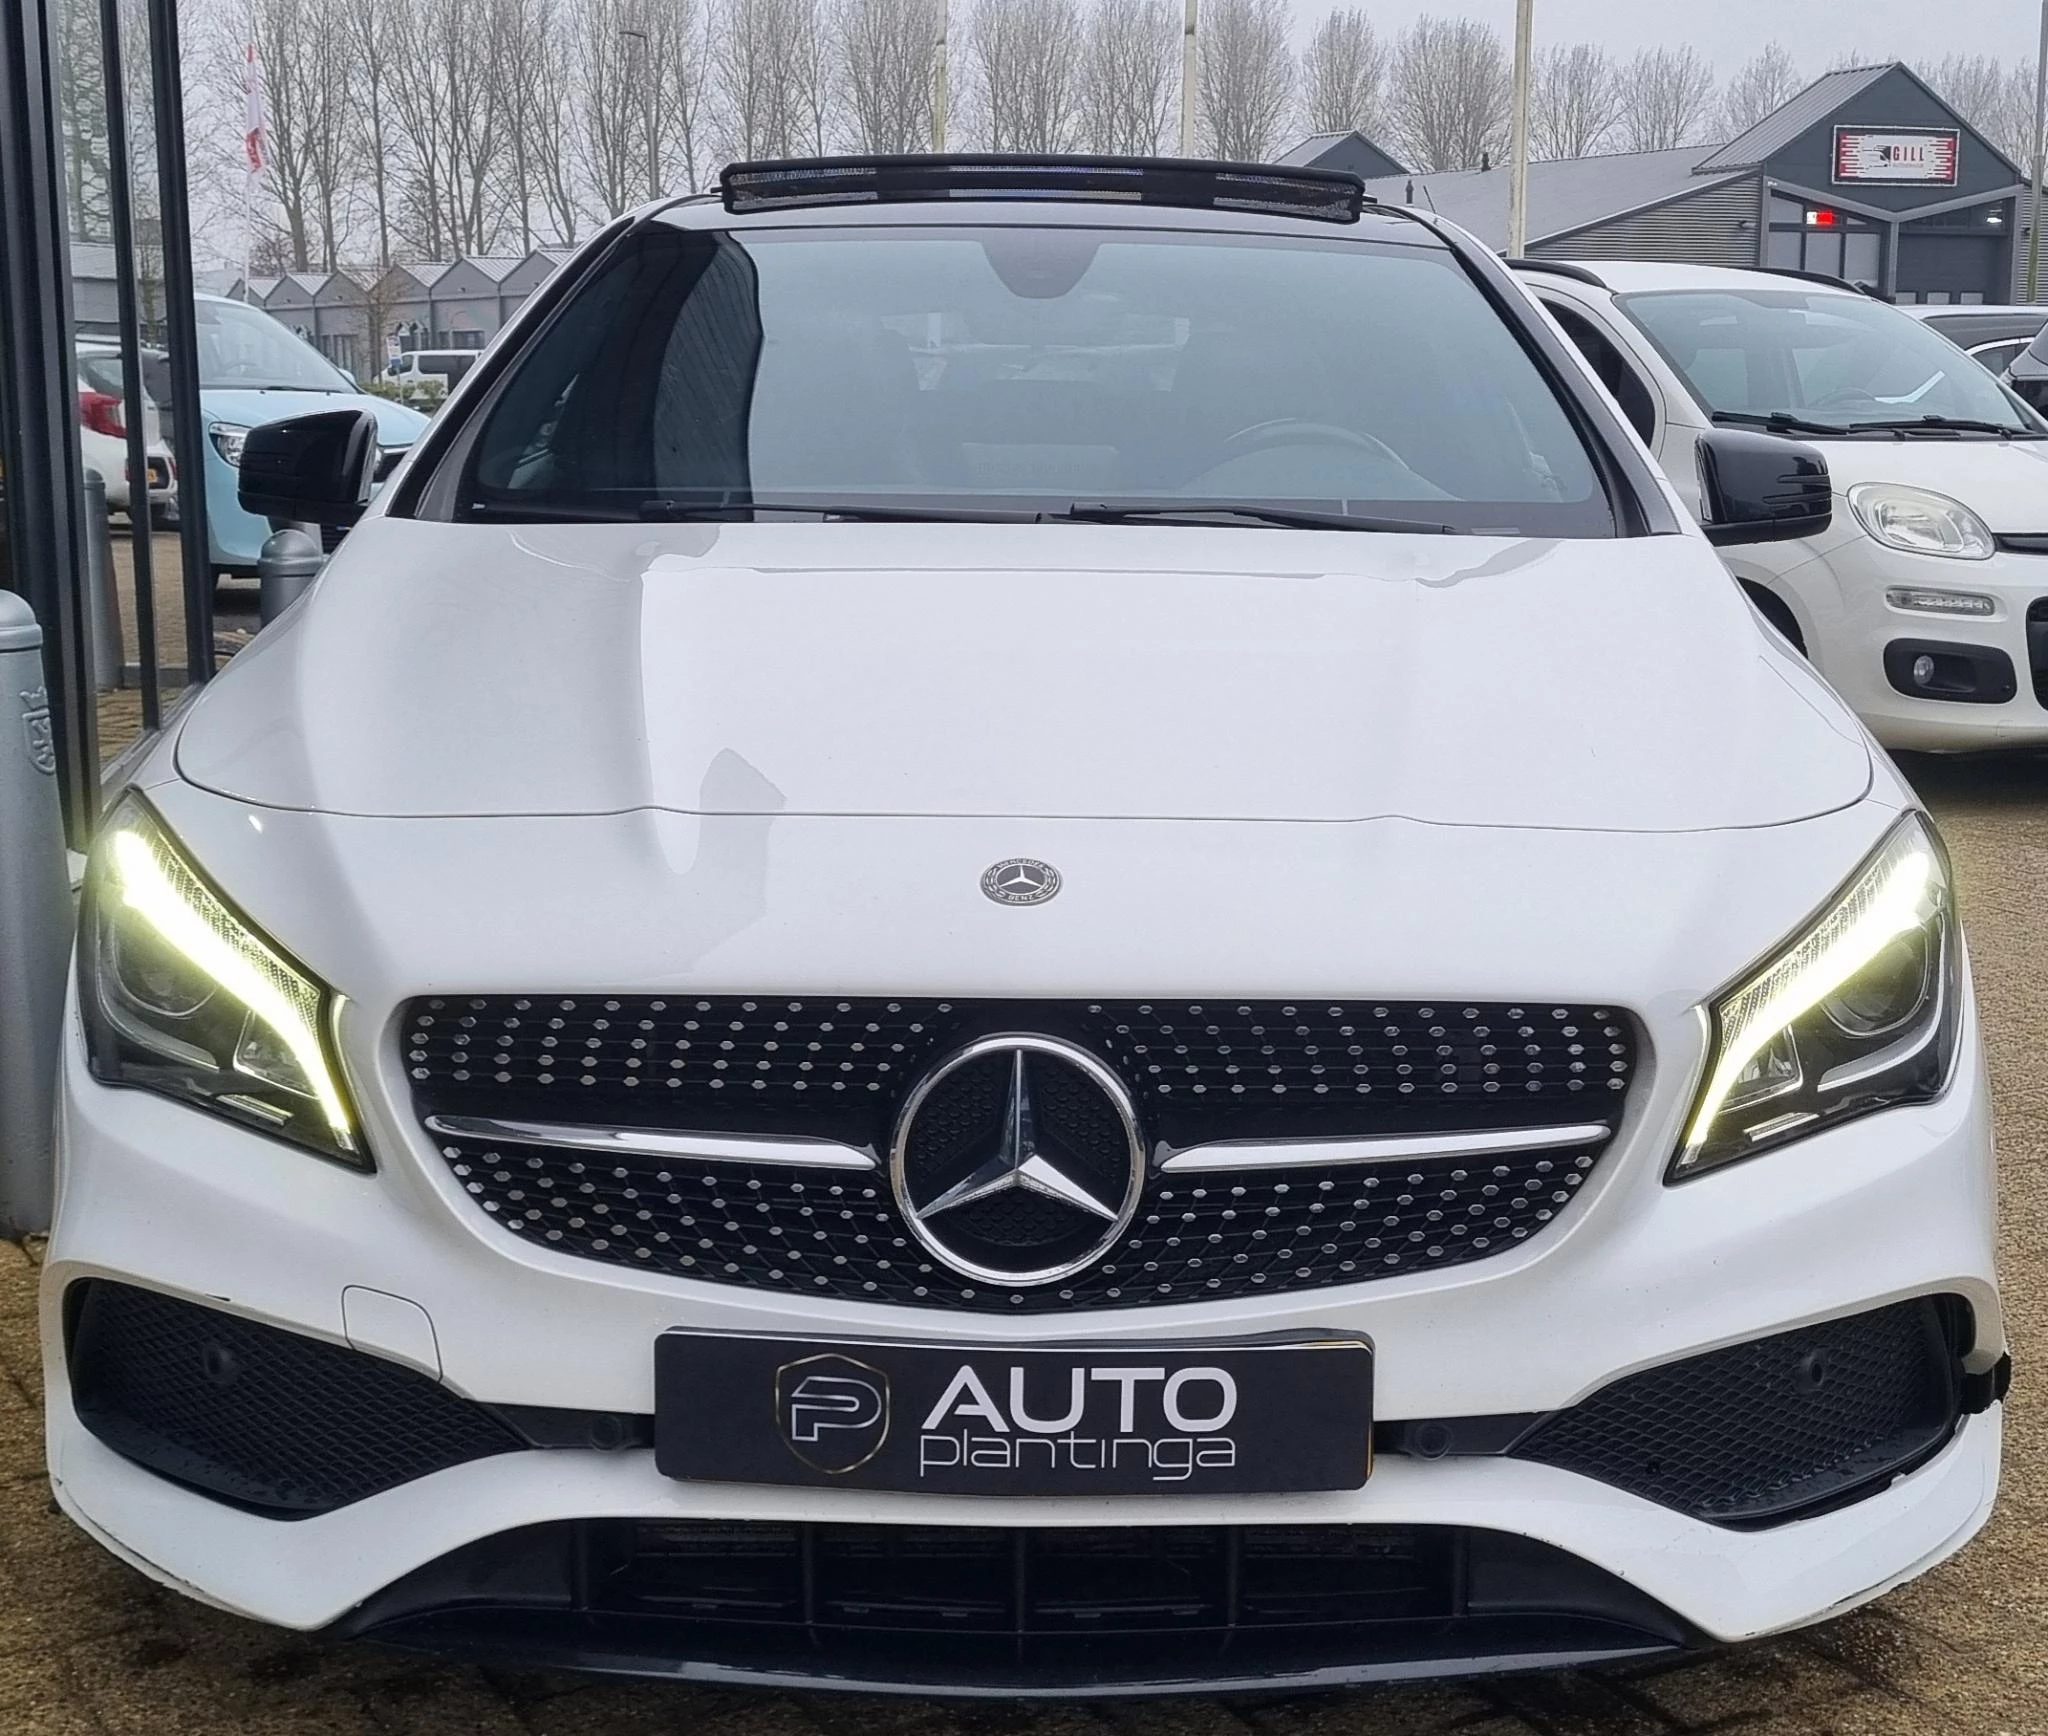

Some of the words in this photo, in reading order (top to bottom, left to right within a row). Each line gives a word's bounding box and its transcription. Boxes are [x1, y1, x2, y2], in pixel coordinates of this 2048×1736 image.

[1892, 146, 1925, 161] GILL
[921, 1365, 1238, 1434] AUTO
[920, 1429, 1236, 1481] plantinga
